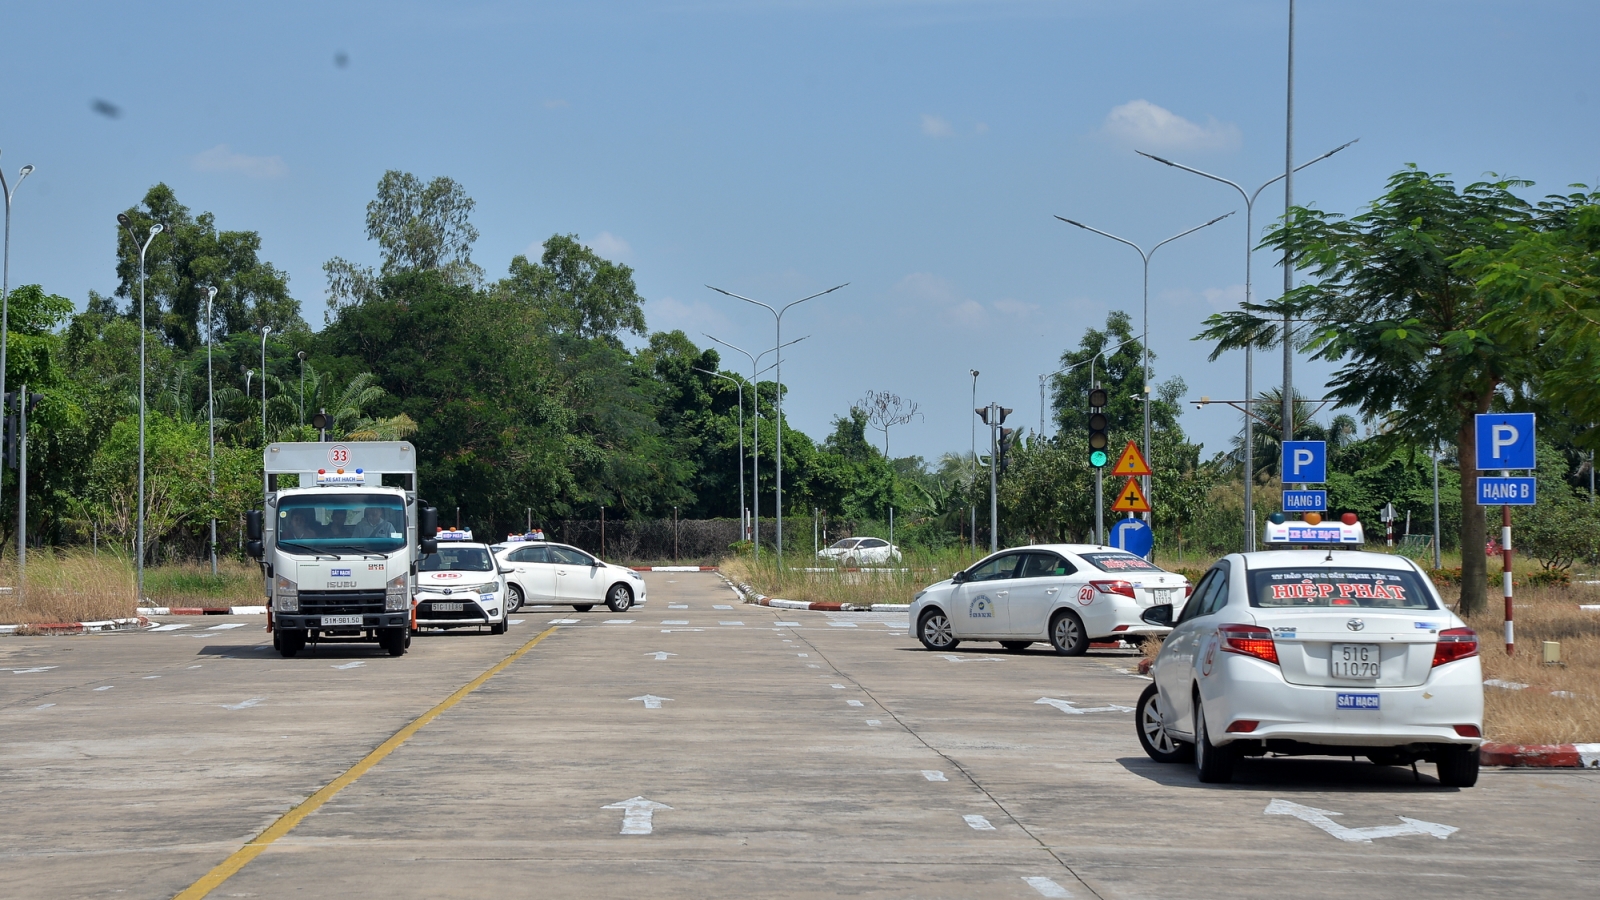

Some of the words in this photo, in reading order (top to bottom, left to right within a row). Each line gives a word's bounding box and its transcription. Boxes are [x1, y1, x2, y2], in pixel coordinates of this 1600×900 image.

[1492, 424, 1519, 458] P
[333, 450, 347, 461] 33
[1293, 449, 1314, 475] P
[1483, 483, 1517, 500] HẠNG
[1520, 483, 1529, 498] B
[1287, 495, 1313, 508] HẠNG
[1315, 495, 1322, 507] B
[1289, 530, 1300, 538] XE
[1302, 528, 1317, 538] SÁT
[1318, 530, 1340, 540] HẠCH
[1080, 588, 1093, 600] 20
[1271, 579, 1334, 602] HIỆP
[1336, 580, 1406, 600] PHÁT
[1343, 647, 1369, 661] 51G
[1334, 662, 1379, 676] 110.70
[1338, 694, 1355, 706] SÁT
[1355, 696, 1378, 708] HẠCH
